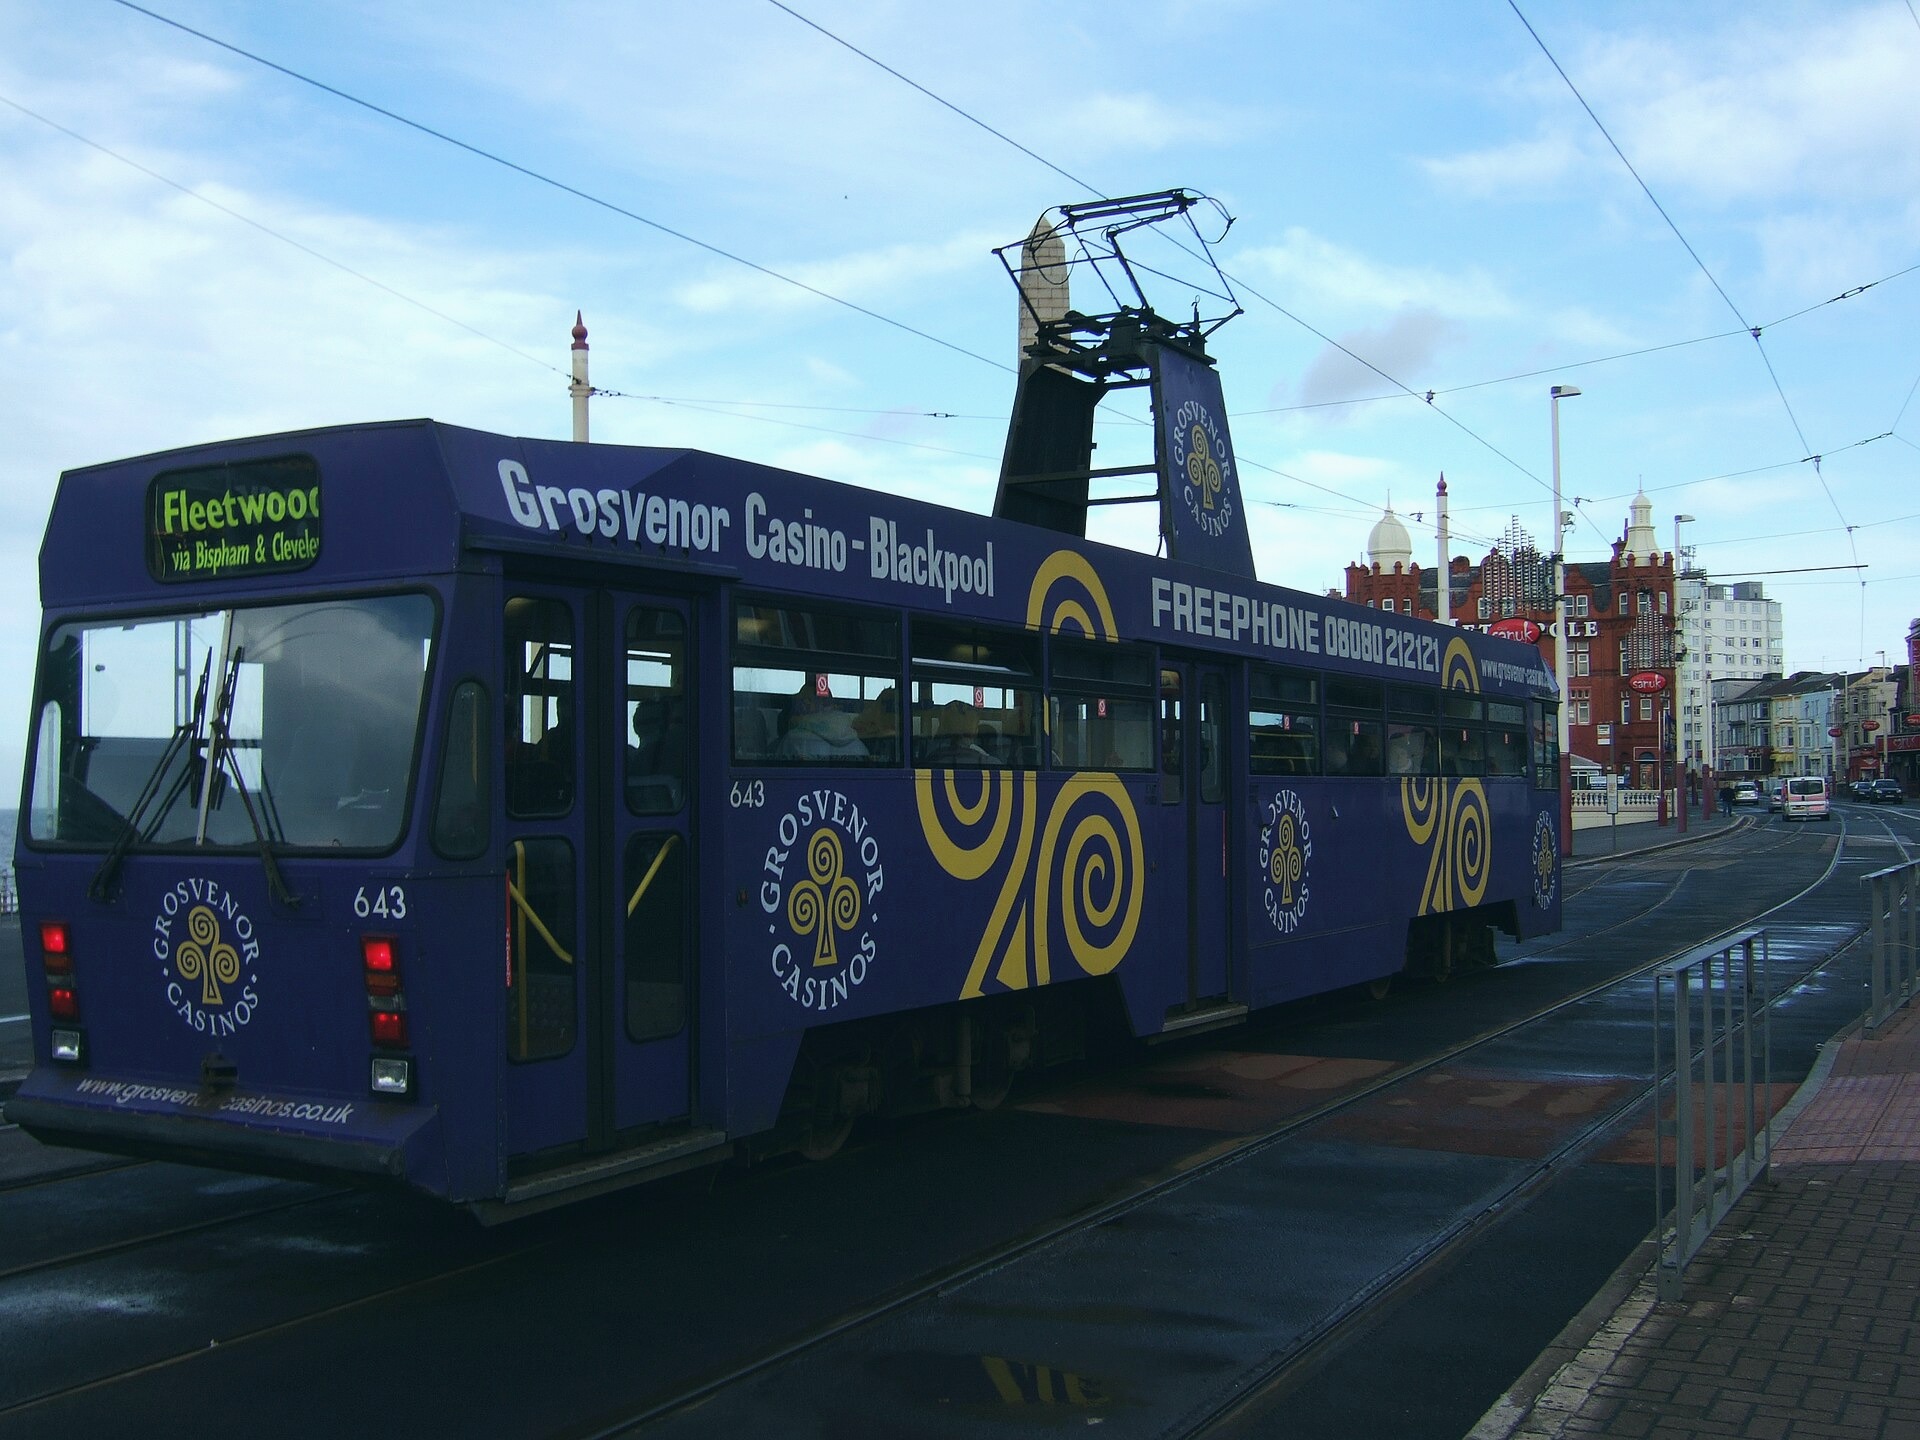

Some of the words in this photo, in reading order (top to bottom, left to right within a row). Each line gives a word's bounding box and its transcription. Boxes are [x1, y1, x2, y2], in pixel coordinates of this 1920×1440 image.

[1173, 401, 1231, 483] GROSVENOR
[497, 458, 731, 554] Grosvenor
[1184, 485, 1233, 537] CASINOS
[171, 542, 192, 572] via
[195, 538, 250, 576] Bispham
[254, 533, 267, 564] &
[271, 528, 320, 562] Clevele
[1151, 576, 1320, 654] FREEPHONE
[1324, 615, 1384, 665] 08080
[1632, 674, 1662, 690] sanuk
[729, 779, 765, 809] 643
[760, 789, 885, 914] GROSVENOR
[1260, 789, 1312, 869] GROSVENOR
[153, 878, 260, 962] GROSVENOR
[353, 885, 408, 920] 643
[1264, 882, 1310, 934] CASINOS
[770, 931, 877, 1011] CASINOS
[166, 982, 259, 1037] CASINOS
